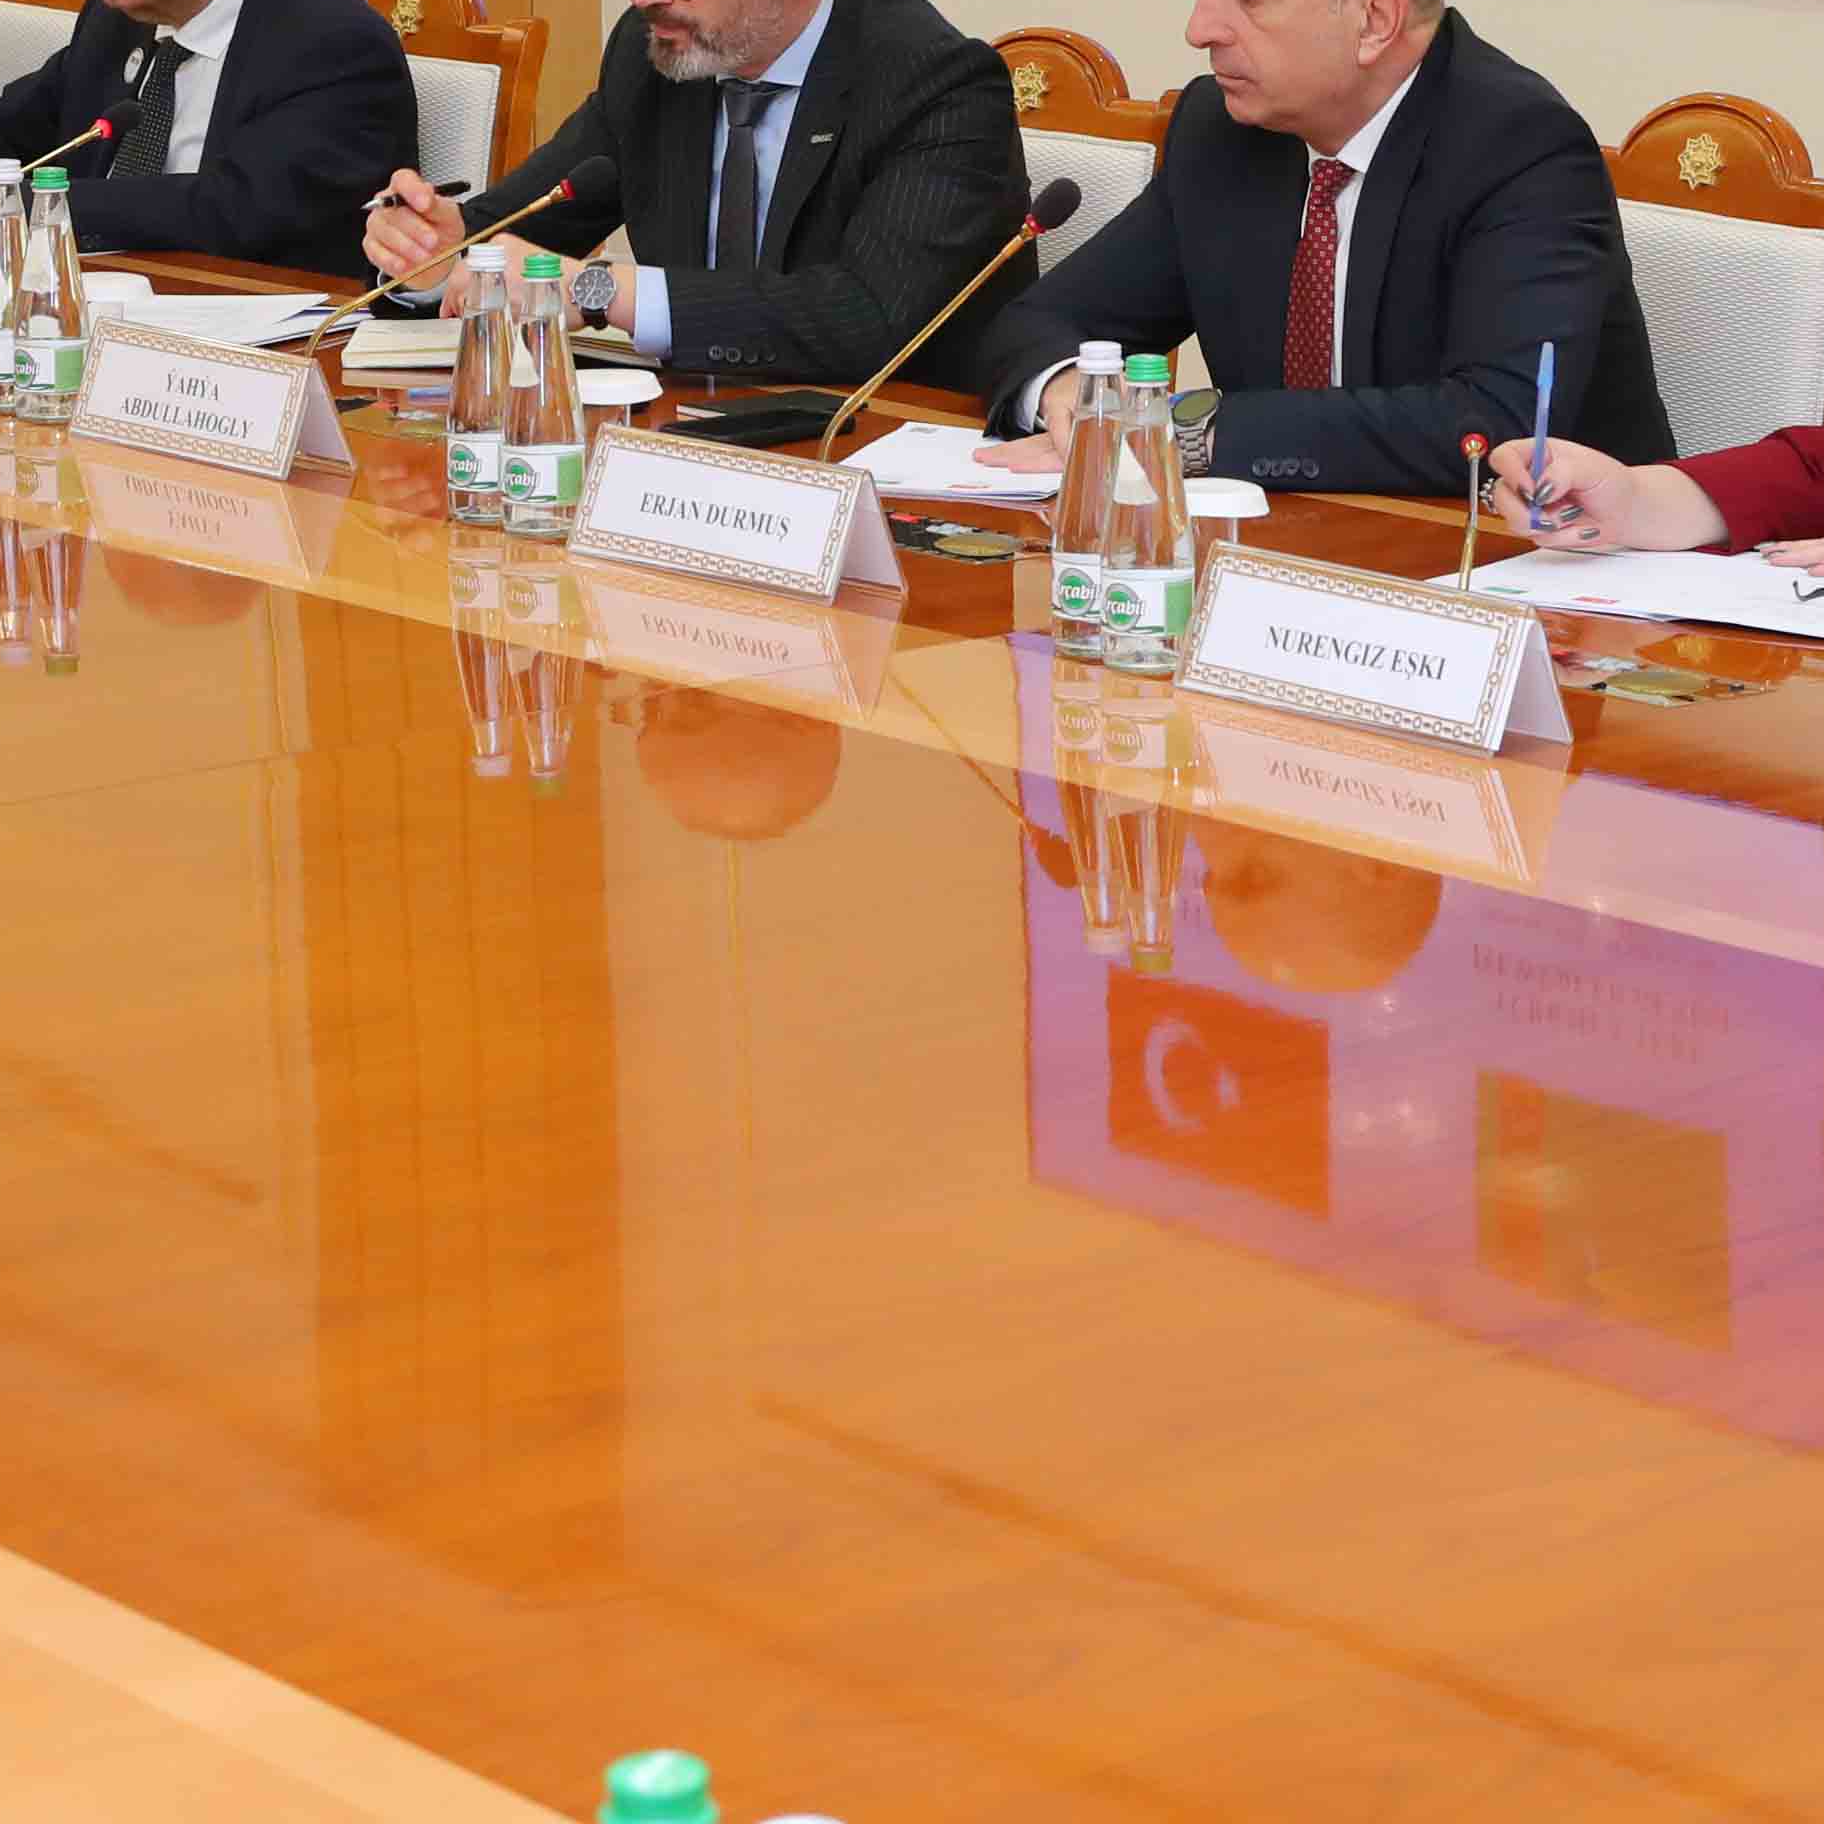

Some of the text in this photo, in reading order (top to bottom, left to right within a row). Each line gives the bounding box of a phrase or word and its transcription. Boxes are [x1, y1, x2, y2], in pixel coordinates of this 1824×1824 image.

[120, 397, 254, 439] ABDULLAHOGLY
[640, 491, 792, 543] ERJAN DURMUŞ
[1263, 625, 1447, 681] NURENGIZ EŞKI
